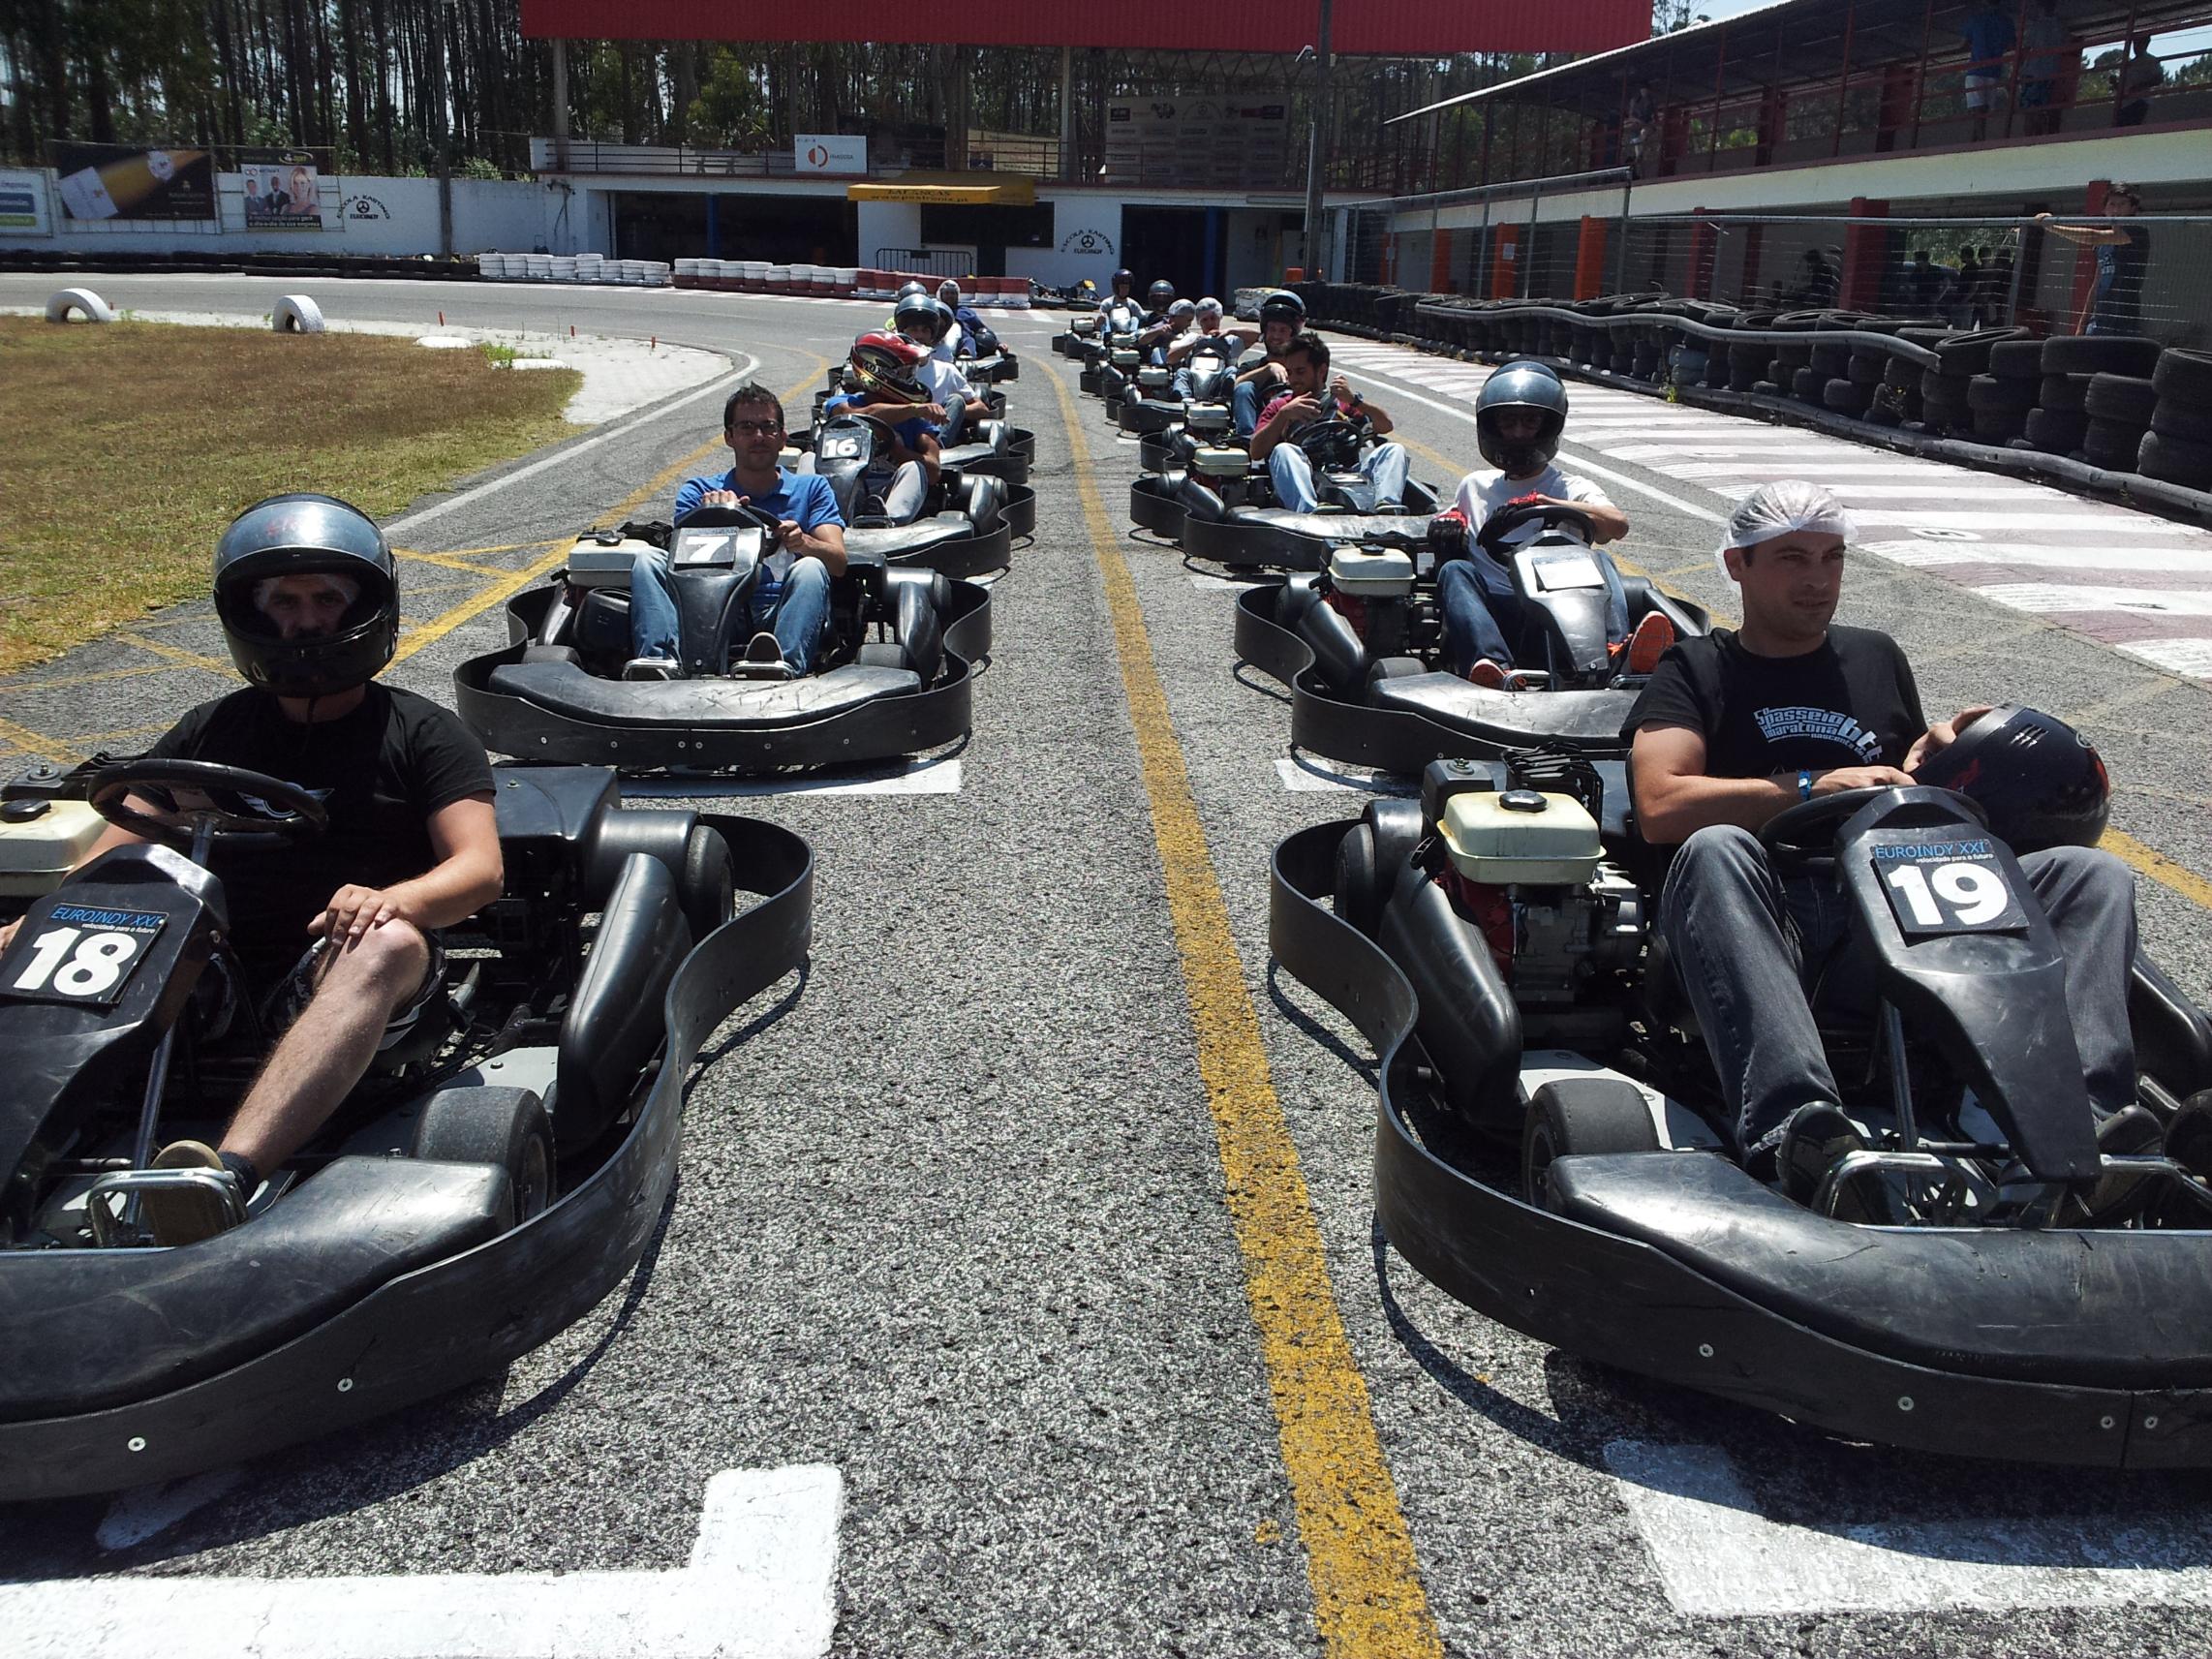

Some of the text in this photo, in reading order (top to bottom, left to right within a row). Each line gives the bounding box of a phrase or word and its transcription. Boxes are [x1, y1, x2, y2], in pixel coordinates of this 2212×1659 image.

[362, 195, 390, 220] KARTING
[1088, 229, 1115, 255] KARTING
[825, 438, 858, 458] 16
[686, 536, 730, 562] 7
[1760, 722, 1838, 739] maratona
[1765, 709, 1845, 729] passeio
[1875, 841, 1986, 859] EUROINDY XXI
[1888, 862, 2009, 926] 19
[50, 906, 161, 928] EUROINDY XXI
[13, 927, 138, 997] 18
